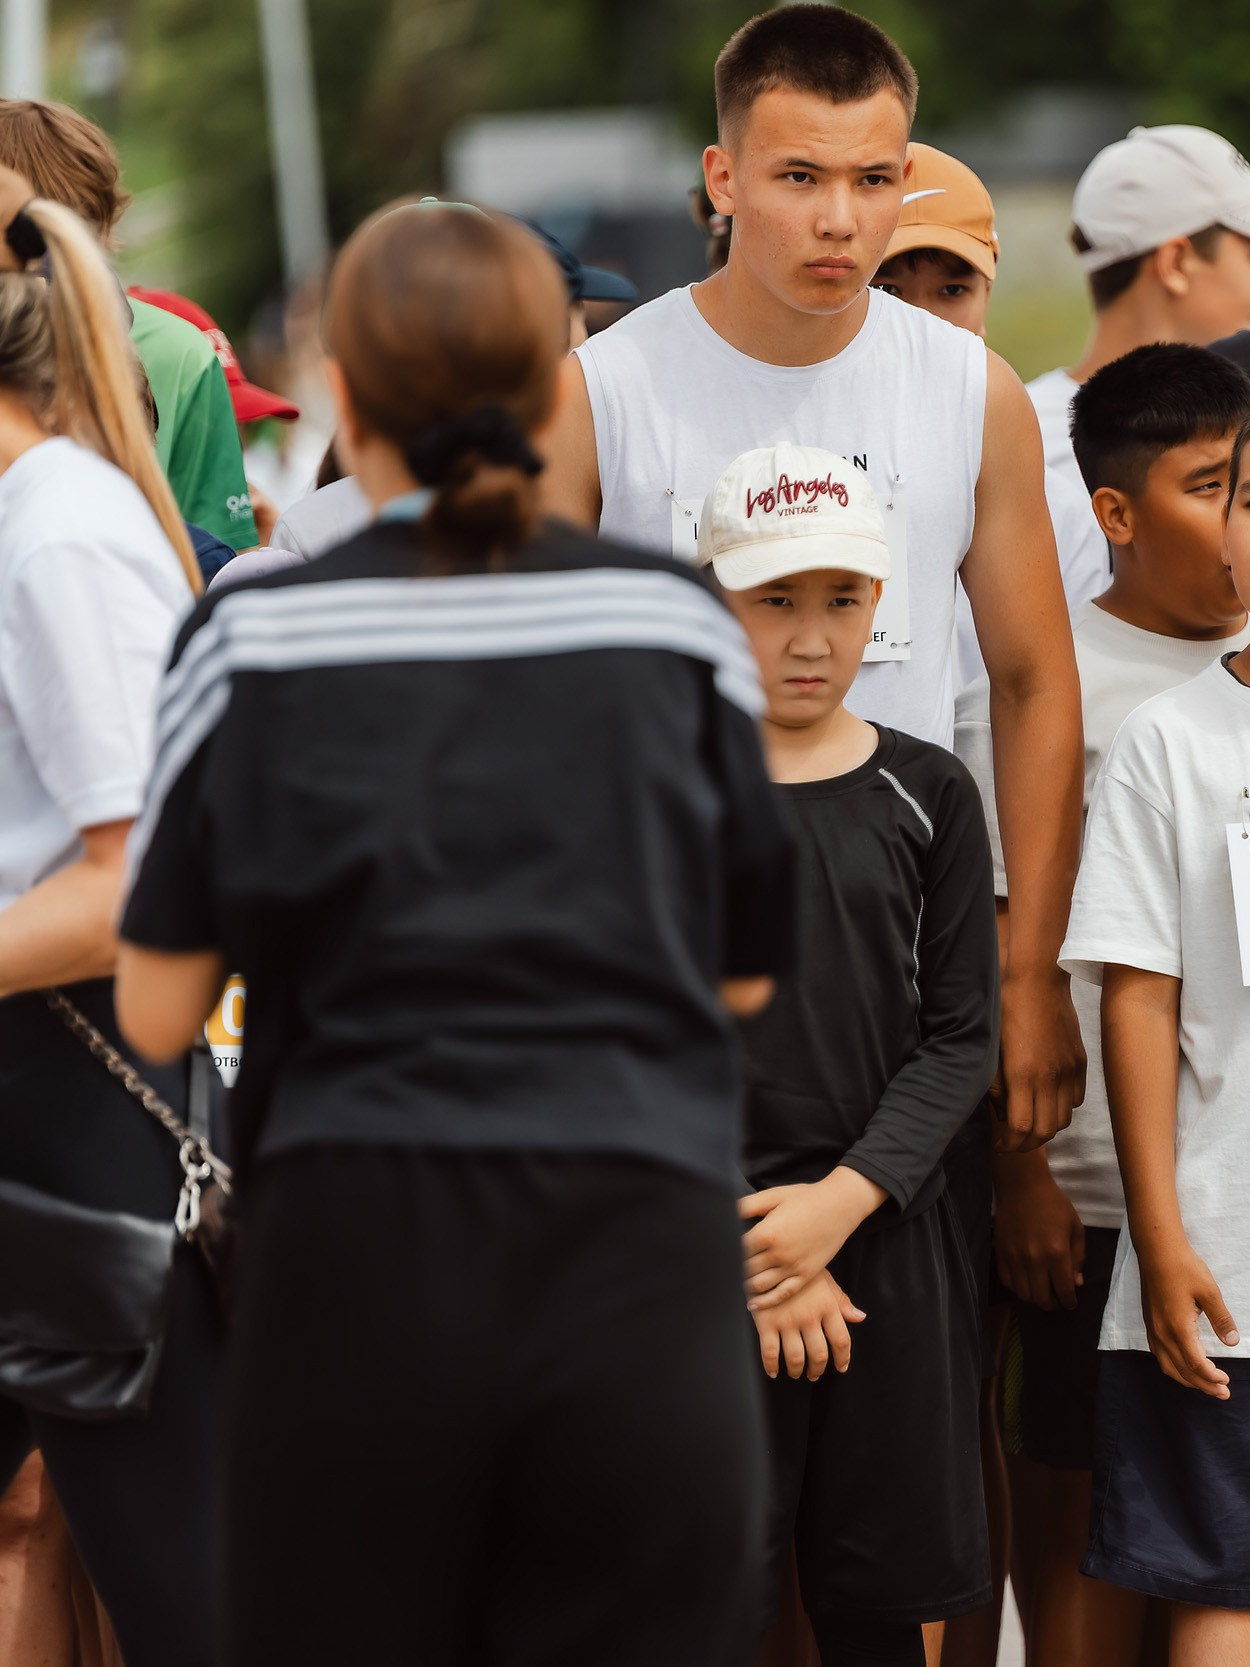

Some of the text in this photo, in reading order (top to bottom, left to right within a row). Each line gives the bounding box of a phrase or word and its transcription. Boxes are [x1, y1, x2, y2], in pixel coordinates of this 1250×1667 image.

[746, 471, 849, 519] Los Angeles
[777, 505, 819, 517] VINTAGE
[222, 986, 246, 1037] 0
